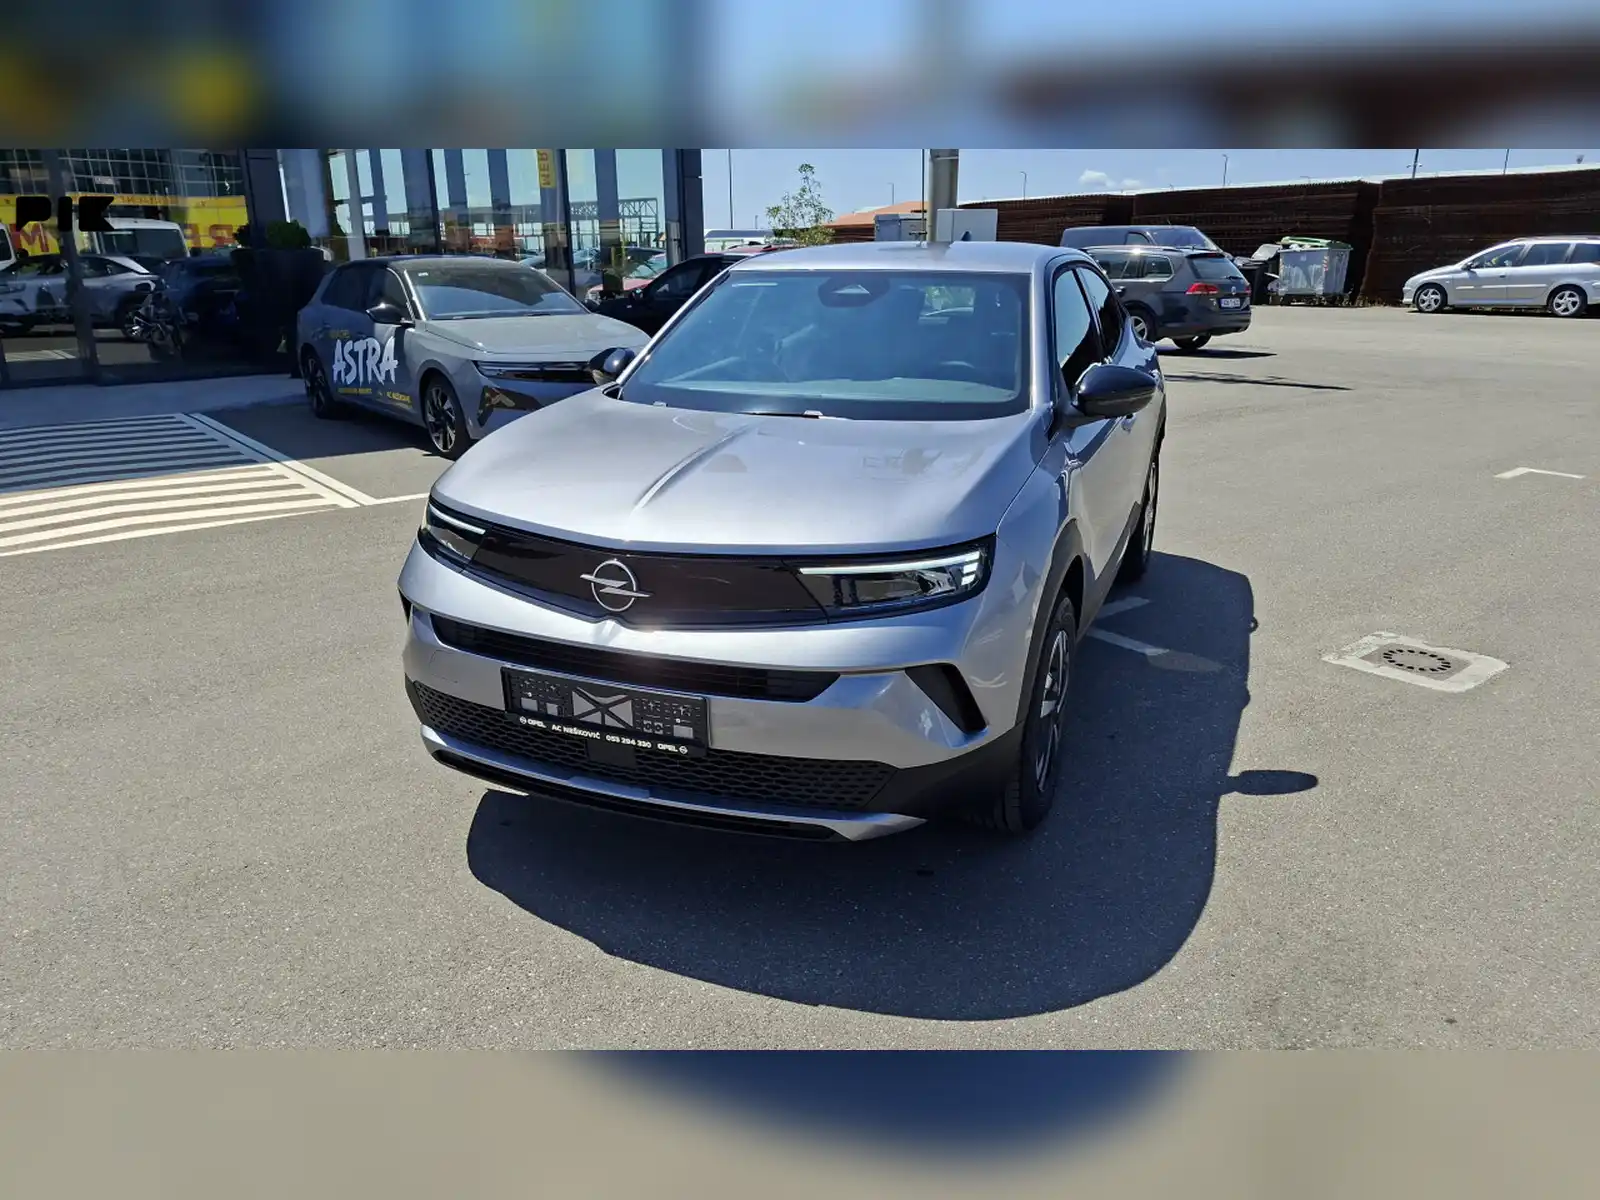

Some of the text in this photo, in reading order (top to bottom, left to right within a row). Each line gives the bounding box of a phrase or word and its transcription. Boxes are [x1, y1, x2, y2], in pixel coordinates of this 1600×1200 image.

[332, 336, 399, 386] ASTRA
[527, 718, 547, 729] OPEL
[551, 724, 562, 732] AC
[657, 743, 679, 752] OPEL
